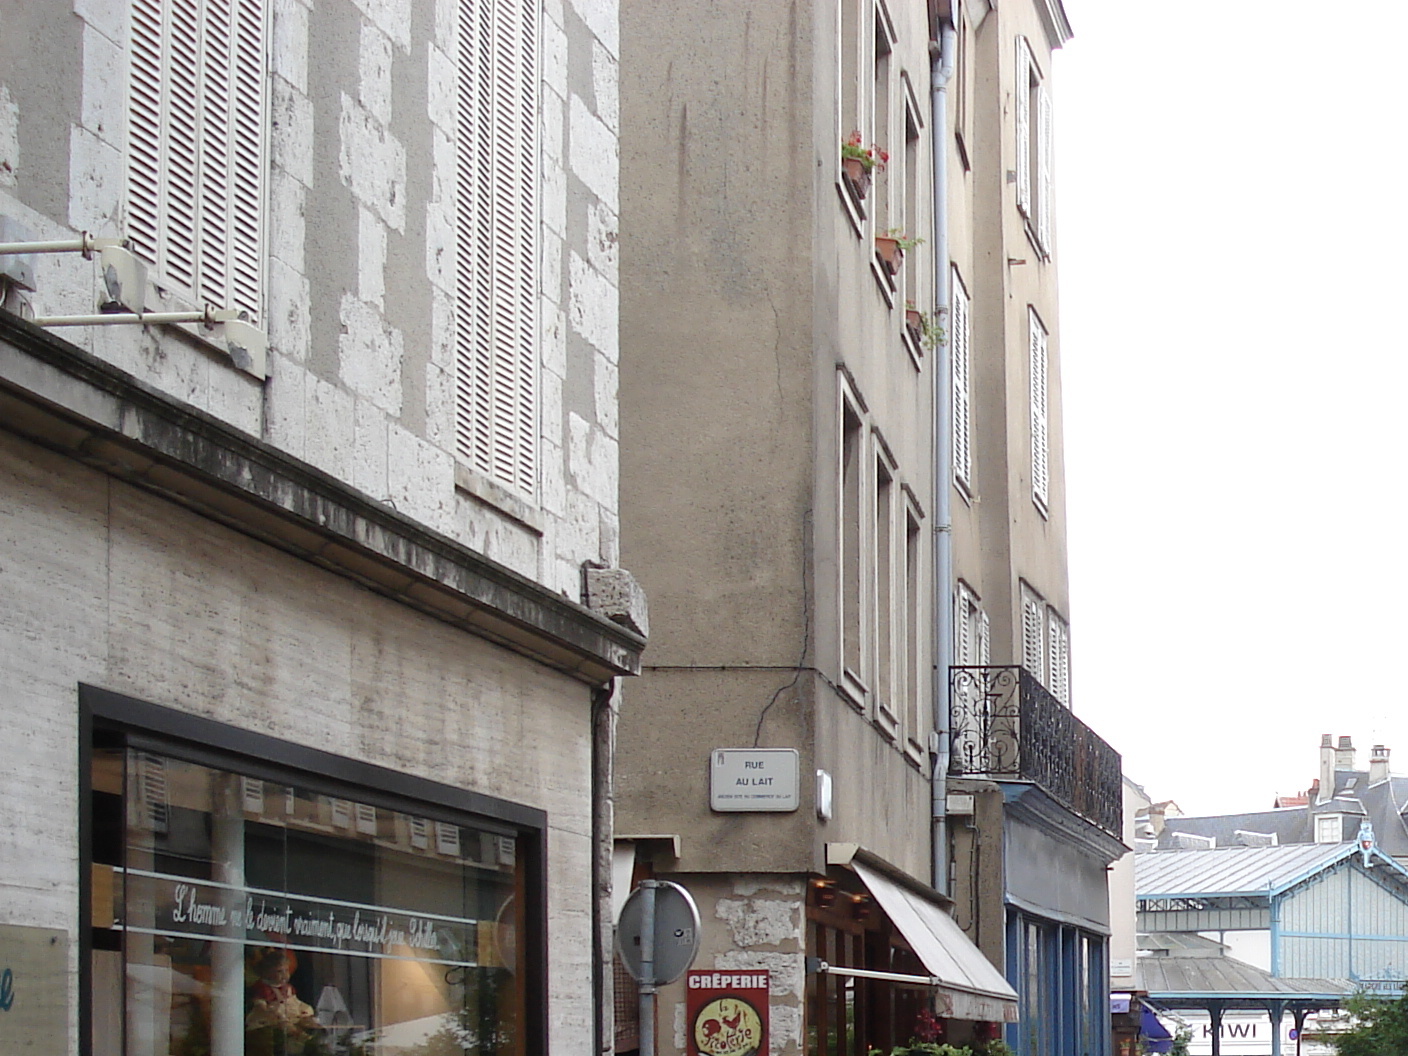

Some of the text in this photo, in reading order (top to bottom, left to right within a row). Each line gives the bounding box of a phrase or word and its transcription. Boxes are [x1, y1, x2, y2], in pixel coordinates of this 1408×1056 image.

[744, 761, 765, 770] RUE
[736, 777, 774, 786] AU LAIT
[173, 884, 228, 926] L'homme
[688, 972, 768, 989] CRÊPERIE
[1203, 1023, 1256, 1038] KIWI
